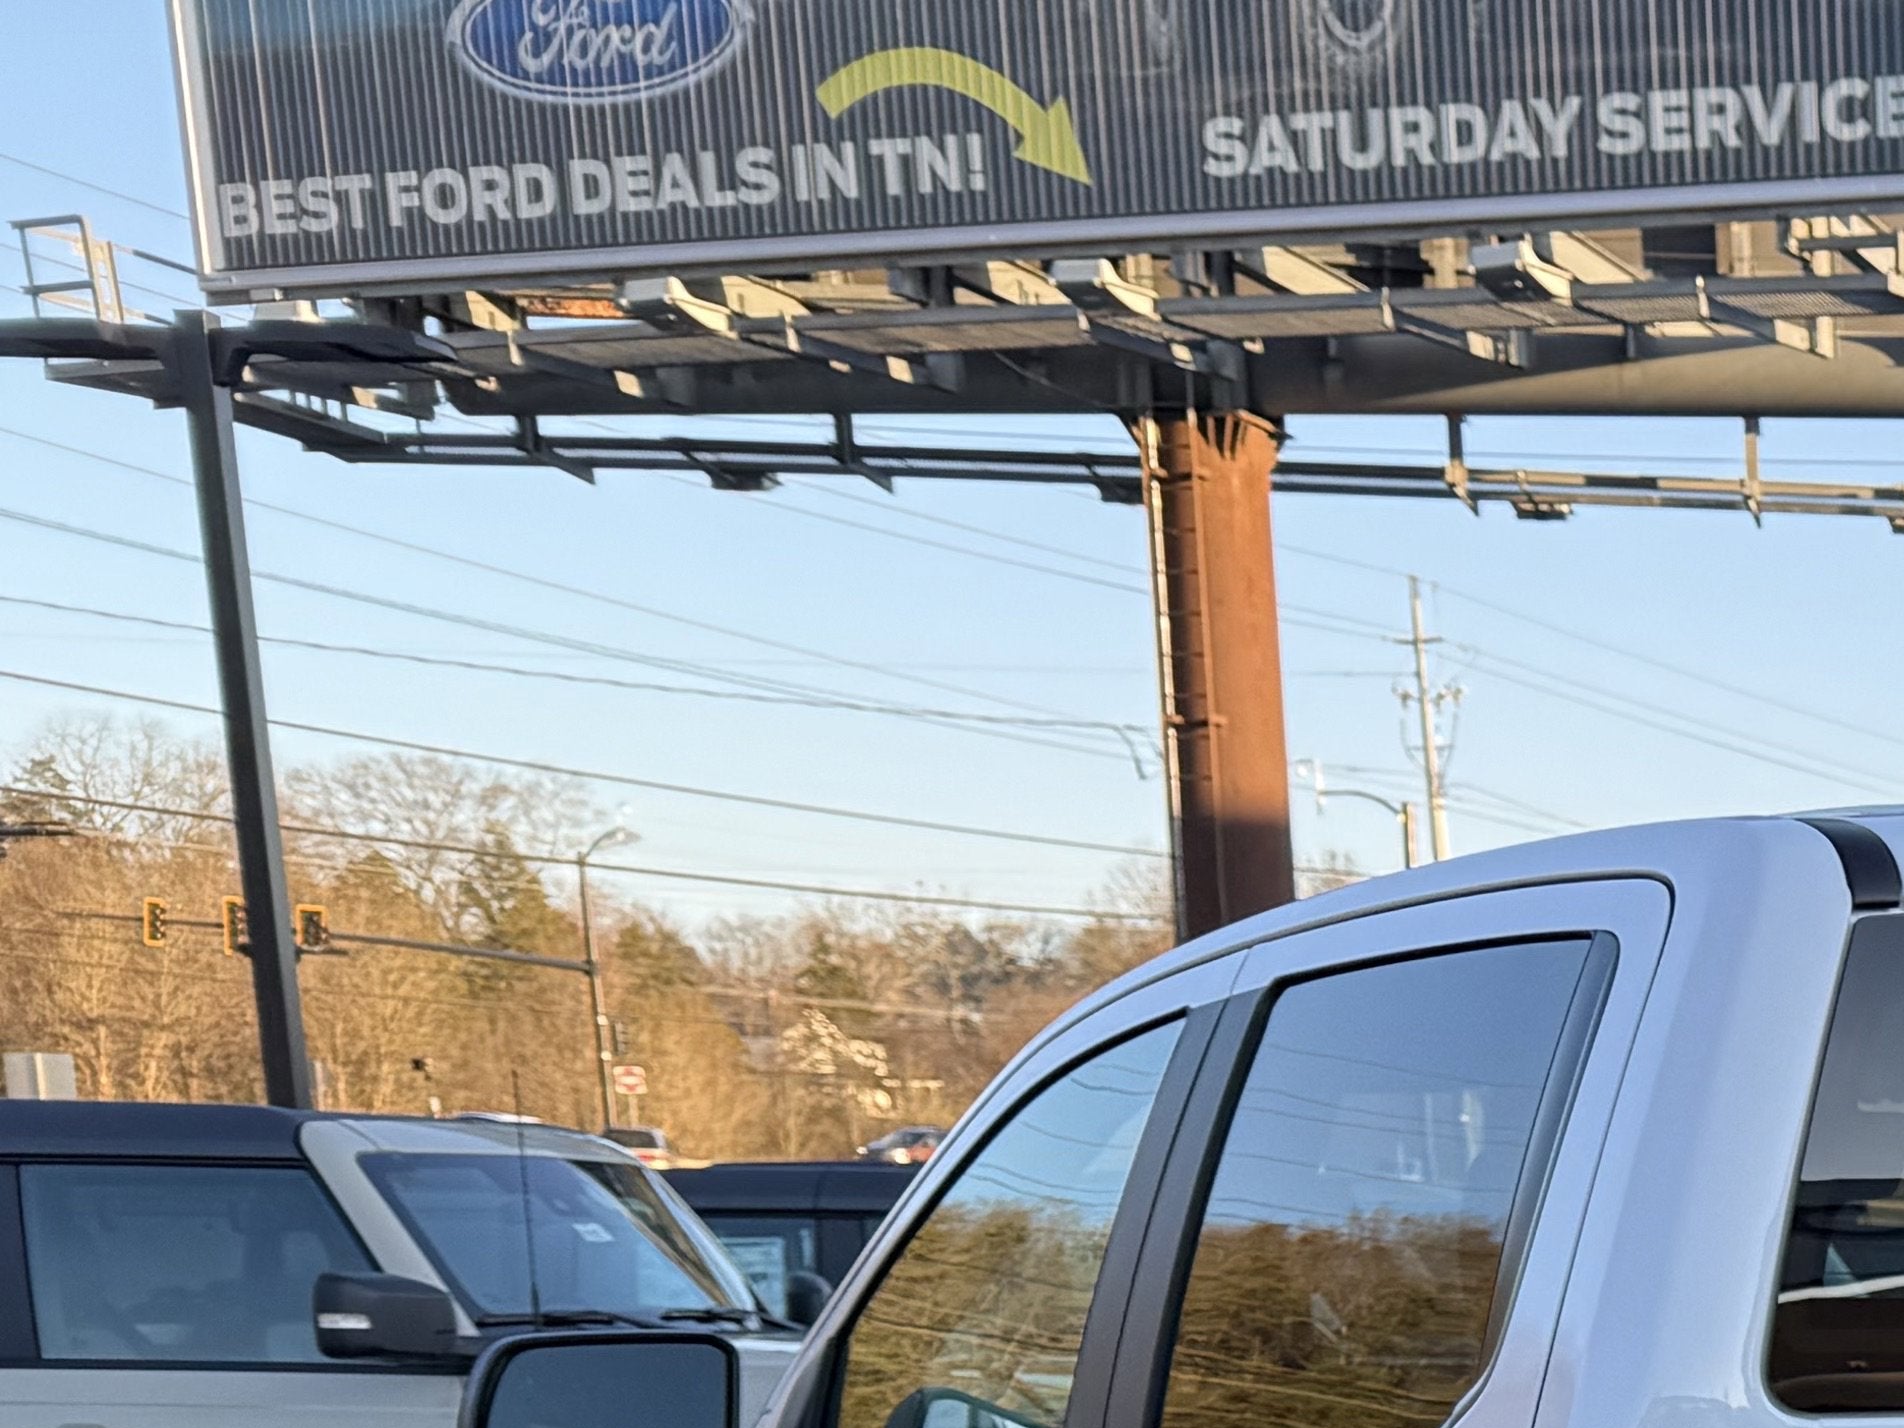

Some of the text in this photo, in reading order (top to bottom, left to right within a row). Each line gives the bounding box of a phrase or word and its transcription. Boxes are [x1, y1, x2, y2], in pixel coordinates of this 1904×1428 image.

[518, 0, 679, 74] Ford
[1202, 95, 1583, 179] SATURDAY
[218, 131, 987, 240] BEST FORD DEALS IN TN!
